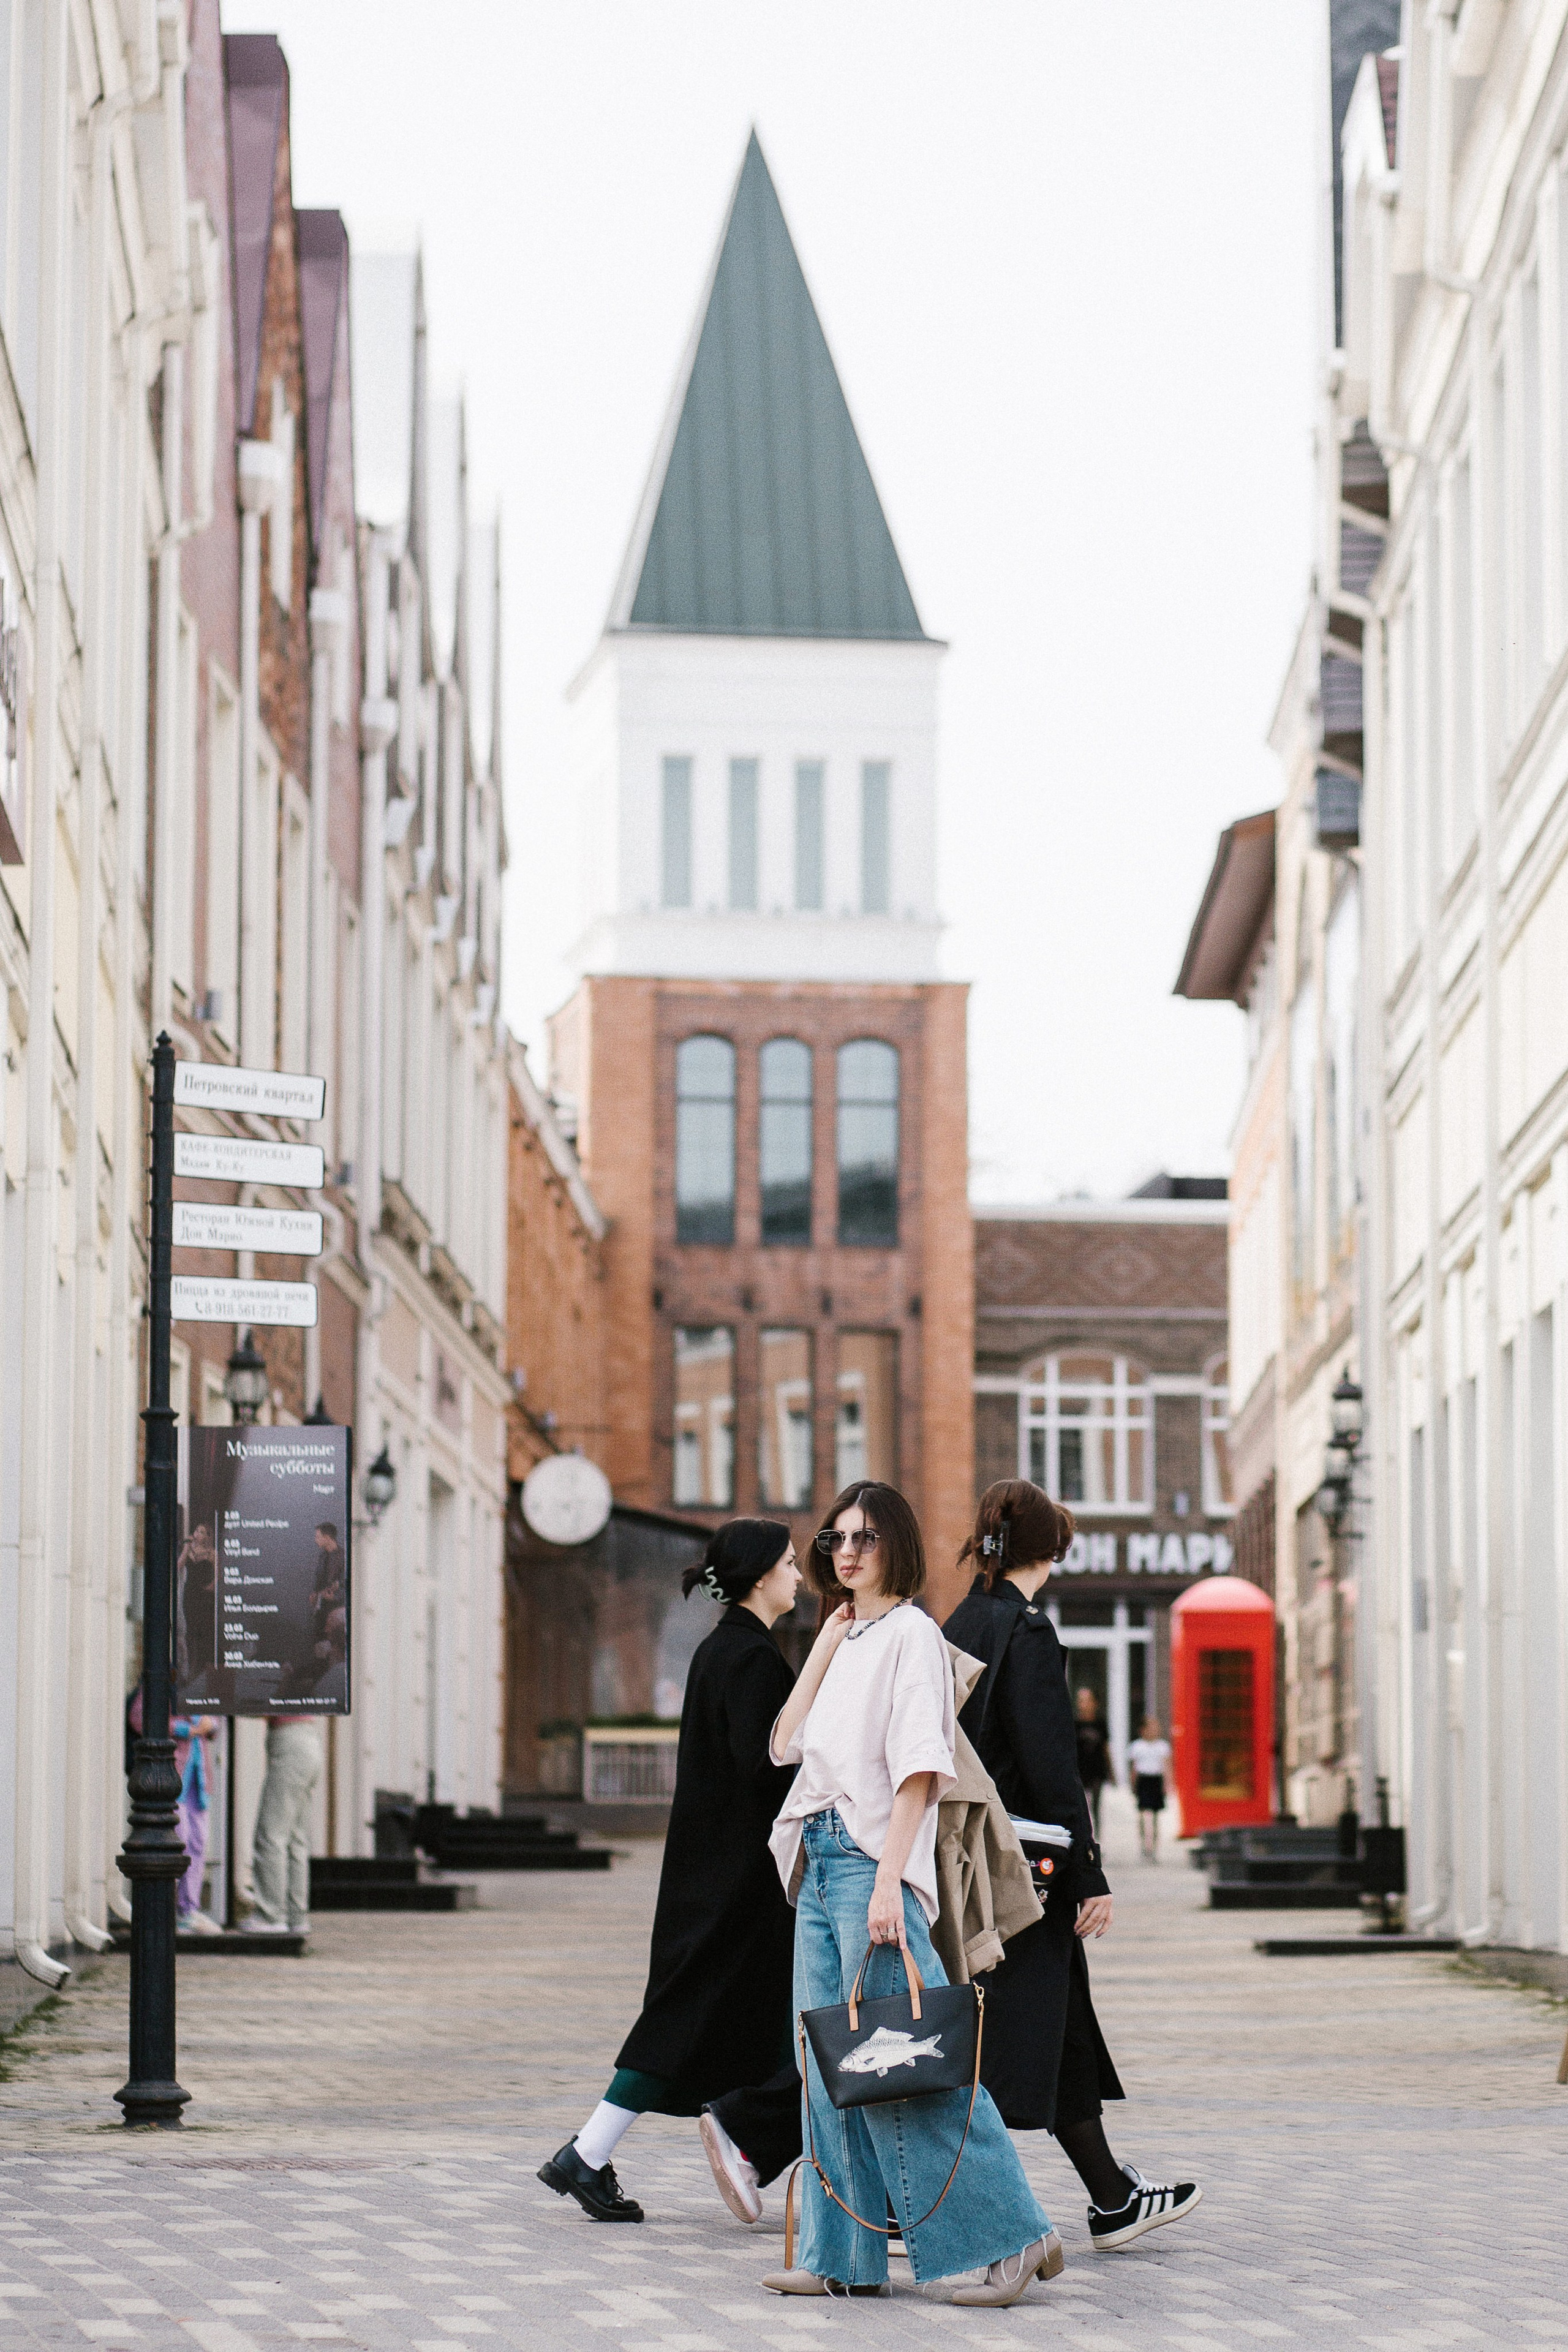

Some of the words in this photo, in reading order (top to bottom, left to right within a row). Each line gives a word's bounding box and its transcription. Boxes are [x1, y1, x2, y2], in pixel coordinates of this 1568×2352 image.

[184, 1074, 258, 1096] Петровский
[264, 1088, 314, 1105] квартал
[182, 1210, 229, 1225] Ресторан
[235, 1213, 274, 1226] Южной
[279, 1216, 314, 1232] Кухни
[181, 1227, 202, 1241] Дон
[207, 1228, 244, 1243] Марио
[175, 1282, 209, 1298] Пицца
[227, 1441, 336, 1461] Музыкальные
[270, 1460, 336, 1479] субботы
[241, 1520, 264, 1528] United
[1049, 1531, 1118, 1577] ОН
